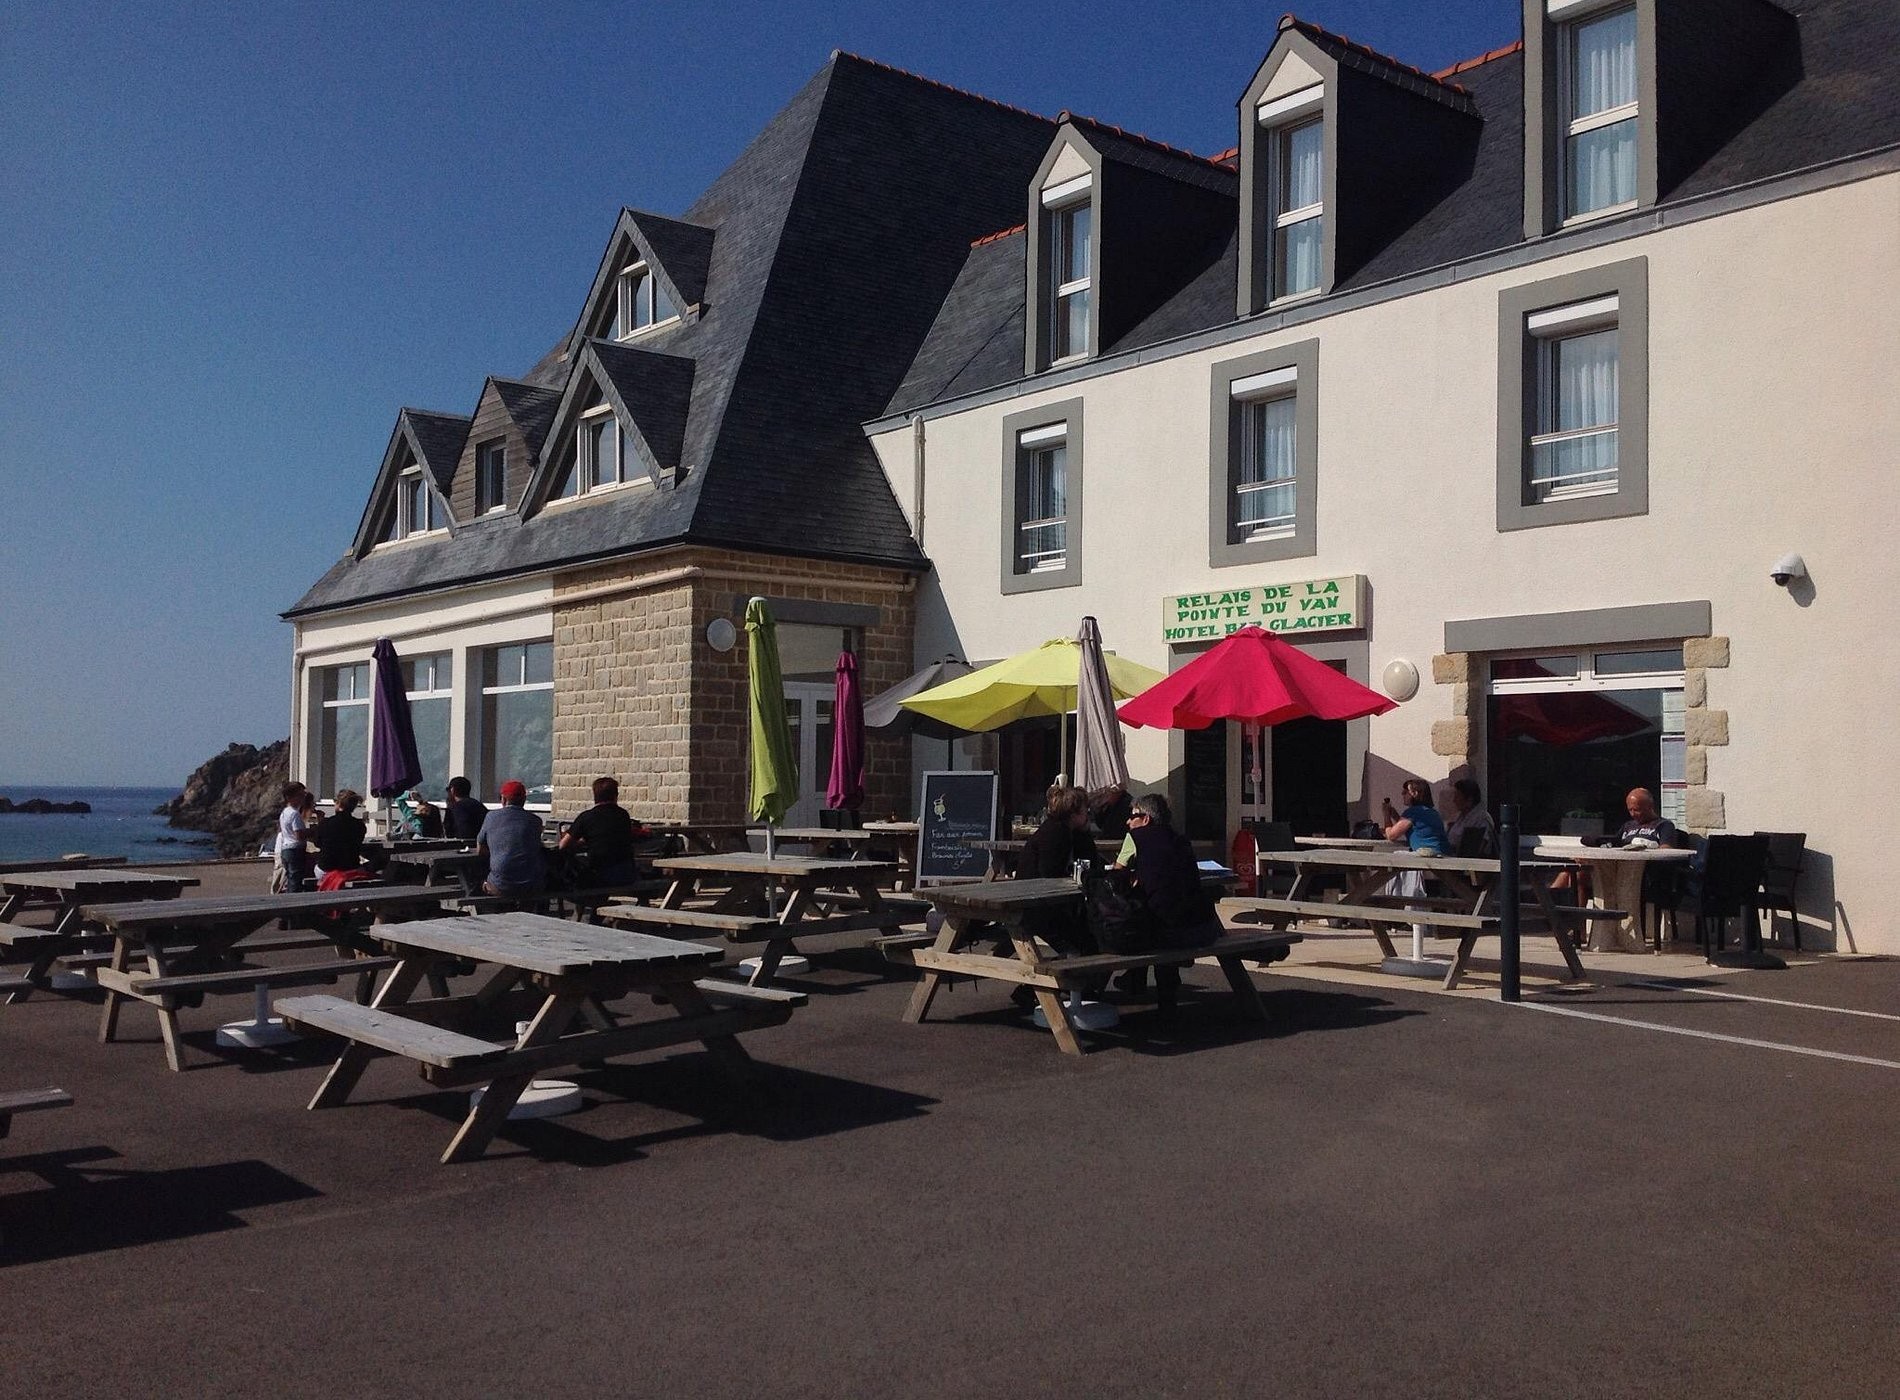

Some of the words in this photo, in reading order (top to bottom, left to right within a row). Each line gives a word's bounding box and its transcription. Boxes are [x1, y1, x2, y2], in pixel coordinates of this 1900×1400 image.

[1176, 590, 1251, 608] RELAIS
[1264, 586, 1293, 599] DE
[1306, 581, 1339, 595] LA
[1177, 604, 1250, 622] POINTE
[1261, 601, 1287, 614] DU
[1299, 596, 1339, 611] VAN
[1165, 625, 1220, 639] HOTEL
[1270, 613, 1352, 630] GLACIER
